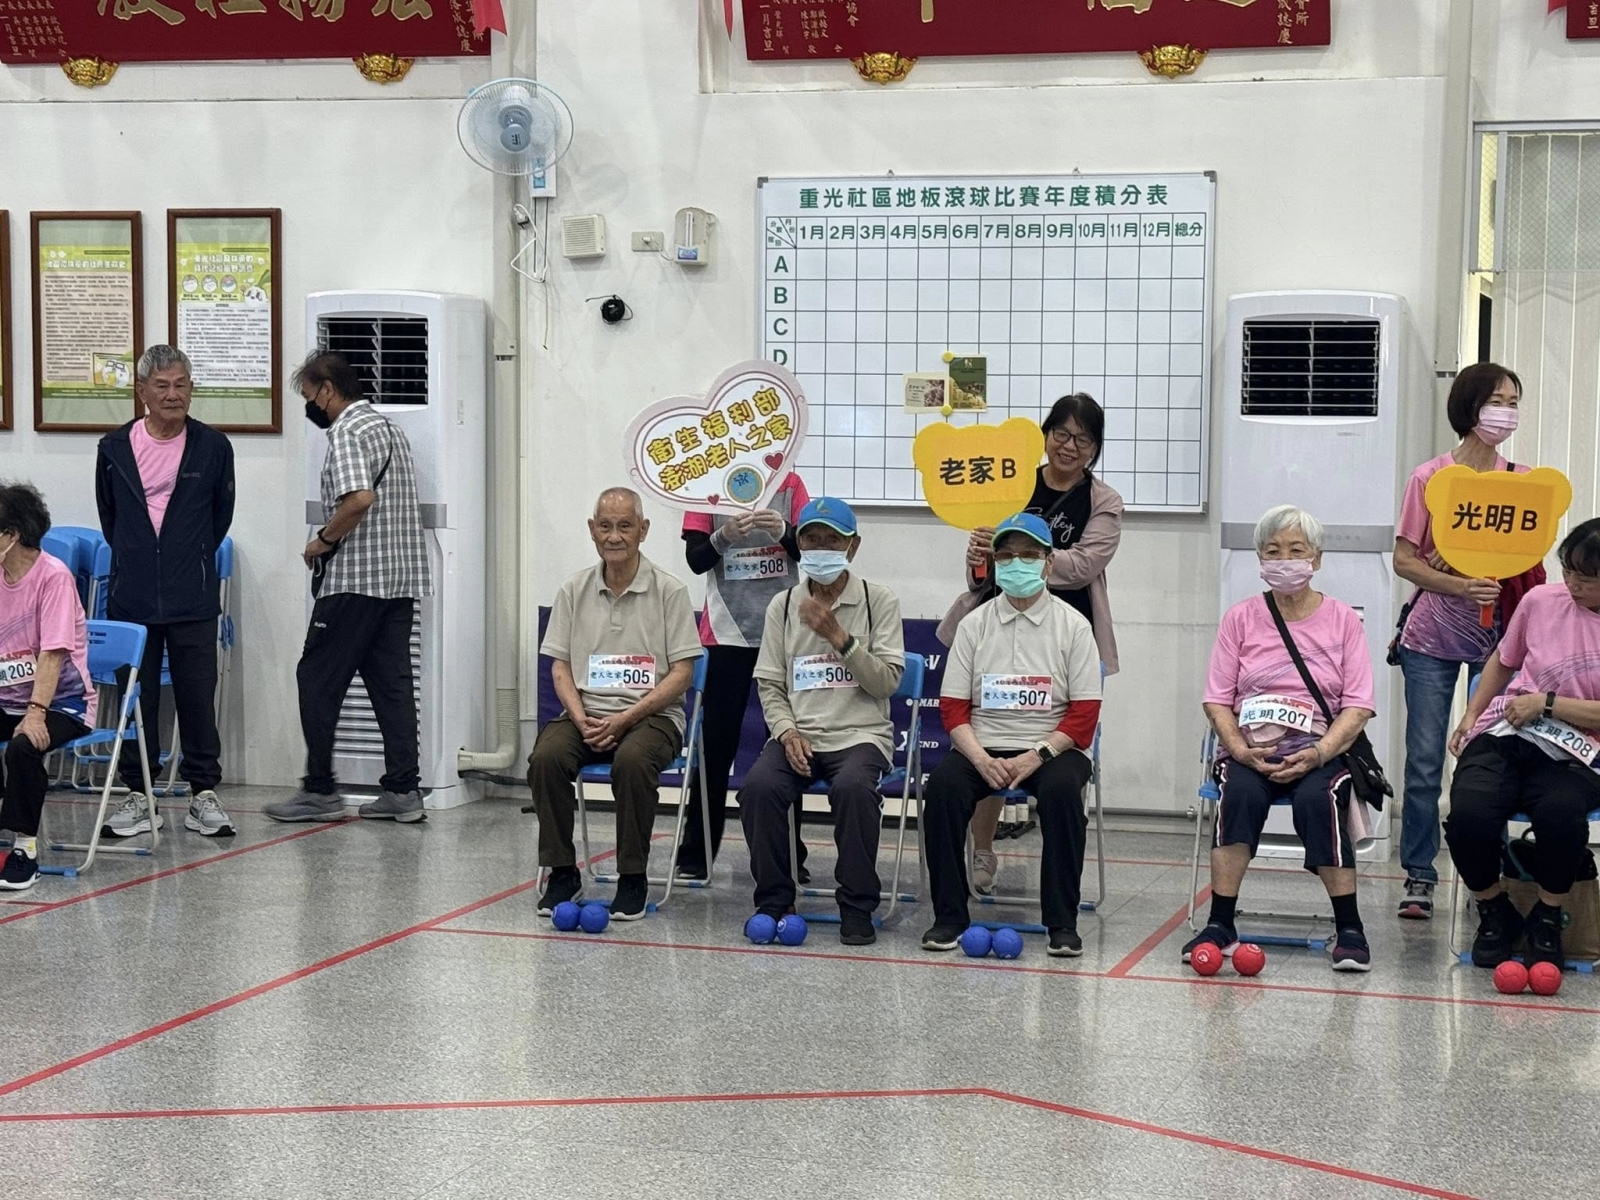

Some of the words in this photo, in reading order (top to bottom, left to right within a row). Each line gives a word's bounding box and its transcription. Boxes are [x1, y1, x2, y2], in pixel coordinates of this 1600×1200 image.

[799, 184, 1169, 209] 重光社區地板滾球比賽年度積分表
[800, 225, 824, 240] 1月
[829, 225, 855, 240] 2月
[860, 225, 886, 240] 3月
[890, 225, 917, 240] 4月
[921, 225, 948, 240] 5月
[952, 224, 979, 240] 6月
[983, 224, 1010, 240] 7月
[1014, 224, 1041, 239] 8月
[1046, 224, 1073, 239] 9月
[1078, 224, 1105, 239] 10月
[1110, 223, 1138, 239] 11月
[1142, 223, 1170, 239] 12月
[1175, 222, 1203, 238] 總分
[774, 256, 789, 273] A
[774, 287, 788, 304] B
[773, 318, 789, 336] C
[774, 349, 788, 366] D
[646, 386, 781, 465] 衛生福利部
[658, 413, 793, 492] 澎湖老人之家
[939, 455, 995, 485] 老家
[1001, 458, 1017, 479] B
[1452, 501, 1516, 533] 光明
[1521, 510, 1538, 531] B
[725, 564, 759, 572] 老人之家
[759, 558, 784, 575] 508
[8, 661, 34, 680] 203
[590, 671, 622, 680] 老人之家
[623, 669, 650, 684] 505
[795, 670, 825, 681] 老人之家
[825, 667, 853, 682] 506
[984, 692, 1018, 701] 老人之家
[1018, 690, 1047, 706] 507
[1242, 709, 1274, 722] 光明
[1277, 708, 1308, 727] 207
[1529, 717, 1562, 739] 光明
[1562, 731, 1593, 758] 208
